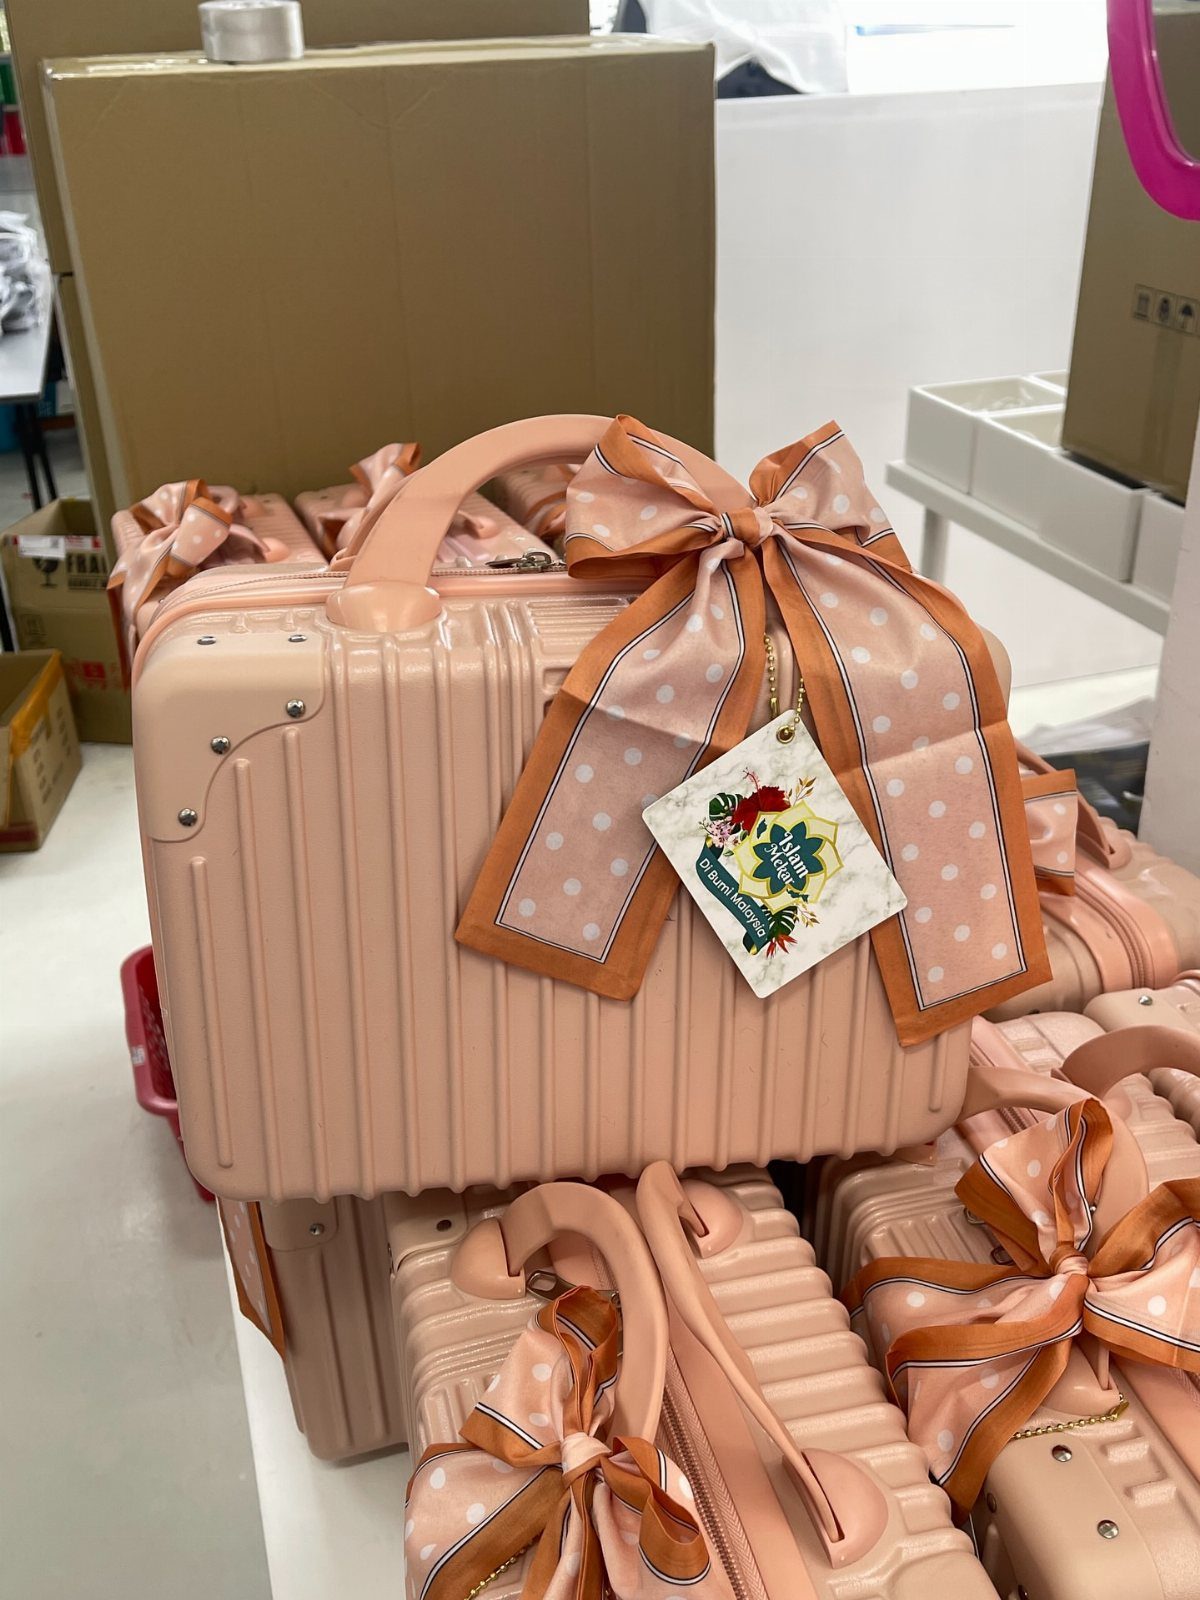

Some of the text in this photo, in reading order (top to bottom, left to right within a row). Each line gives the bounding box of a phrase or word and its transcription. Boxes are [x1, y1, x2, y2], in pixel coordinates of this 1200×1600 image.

[764, 843, 795, 884] Mekar
[779, 831, 809, 878] Islam
[699, 858, 766, 938] Di Bumi Malaysia
